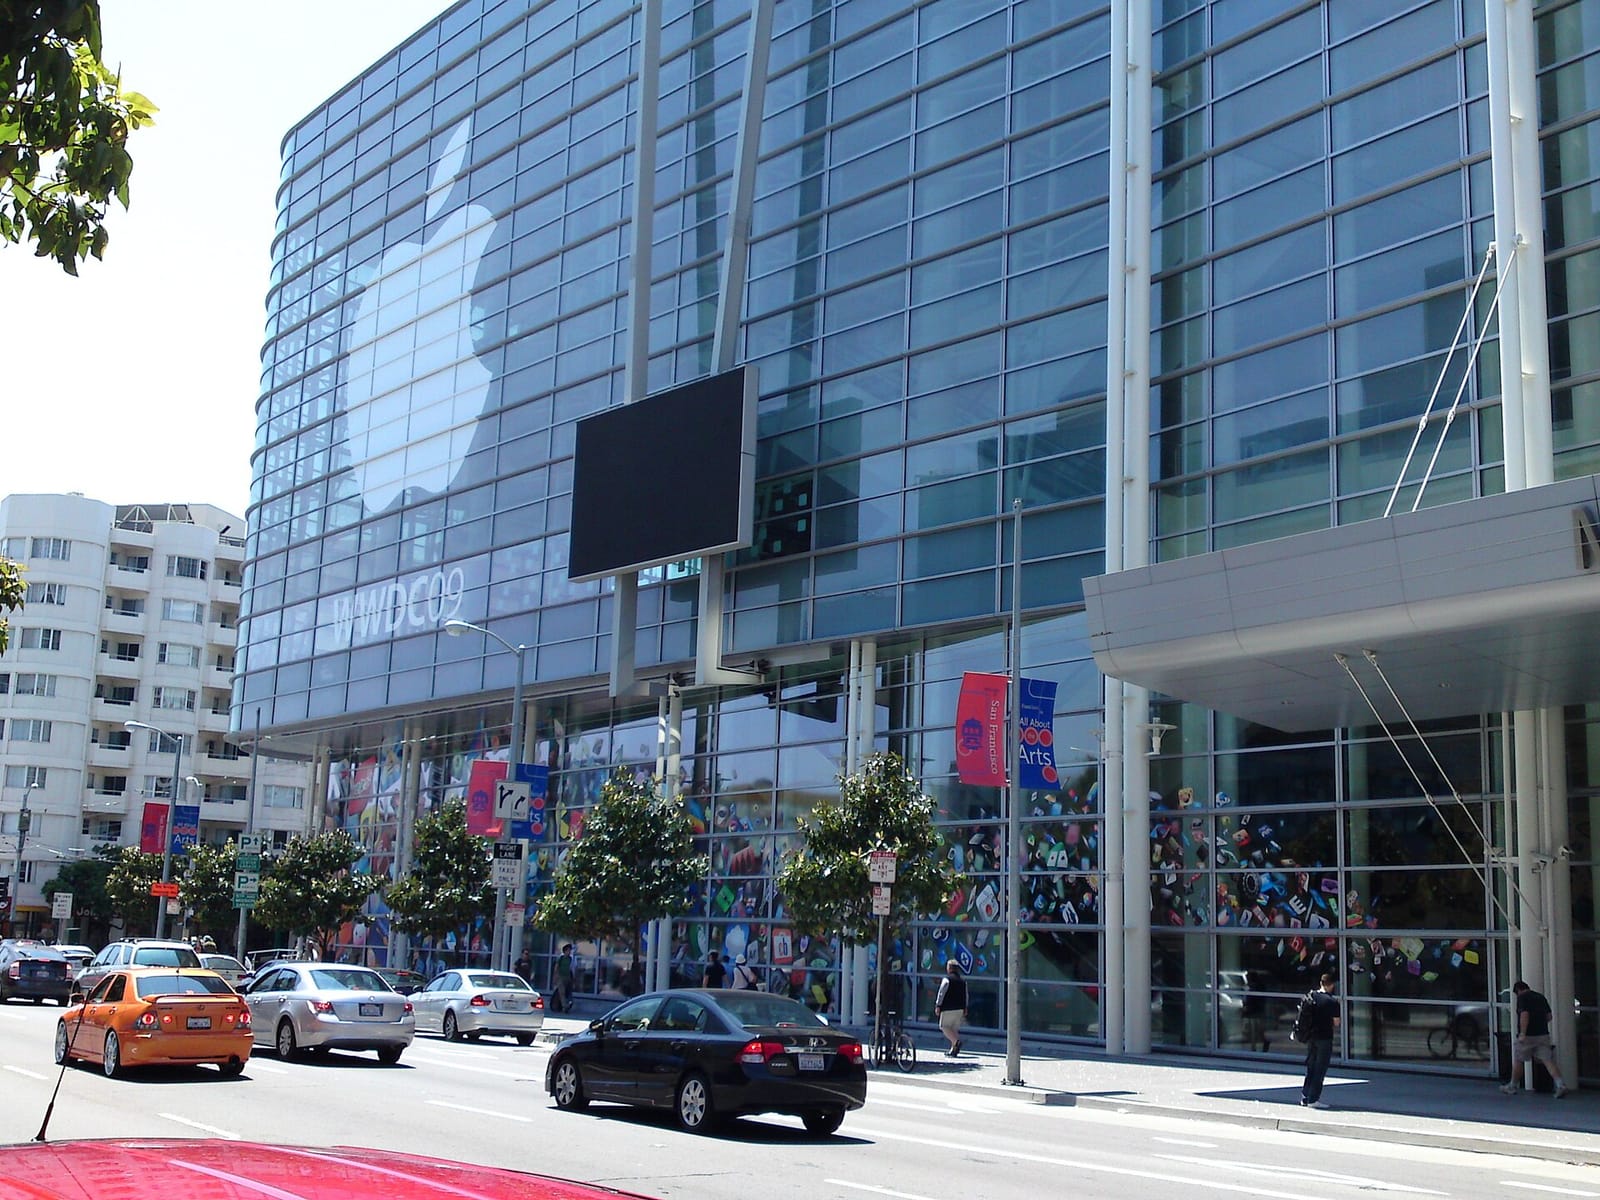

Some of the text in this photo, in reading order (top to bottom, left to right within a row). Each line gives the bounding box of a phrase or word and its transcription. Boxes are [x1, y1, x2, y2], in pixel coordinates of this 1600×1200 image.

[333, 567, 464, 646] WWDC09
[1030, 719, 1051, 728] About
[989, 700, 1000, 775] San Francisco
[1019, 744, 1052, 766] Arts
[241, 837, 251, 849] P
[238, 876, 248, 888] P
